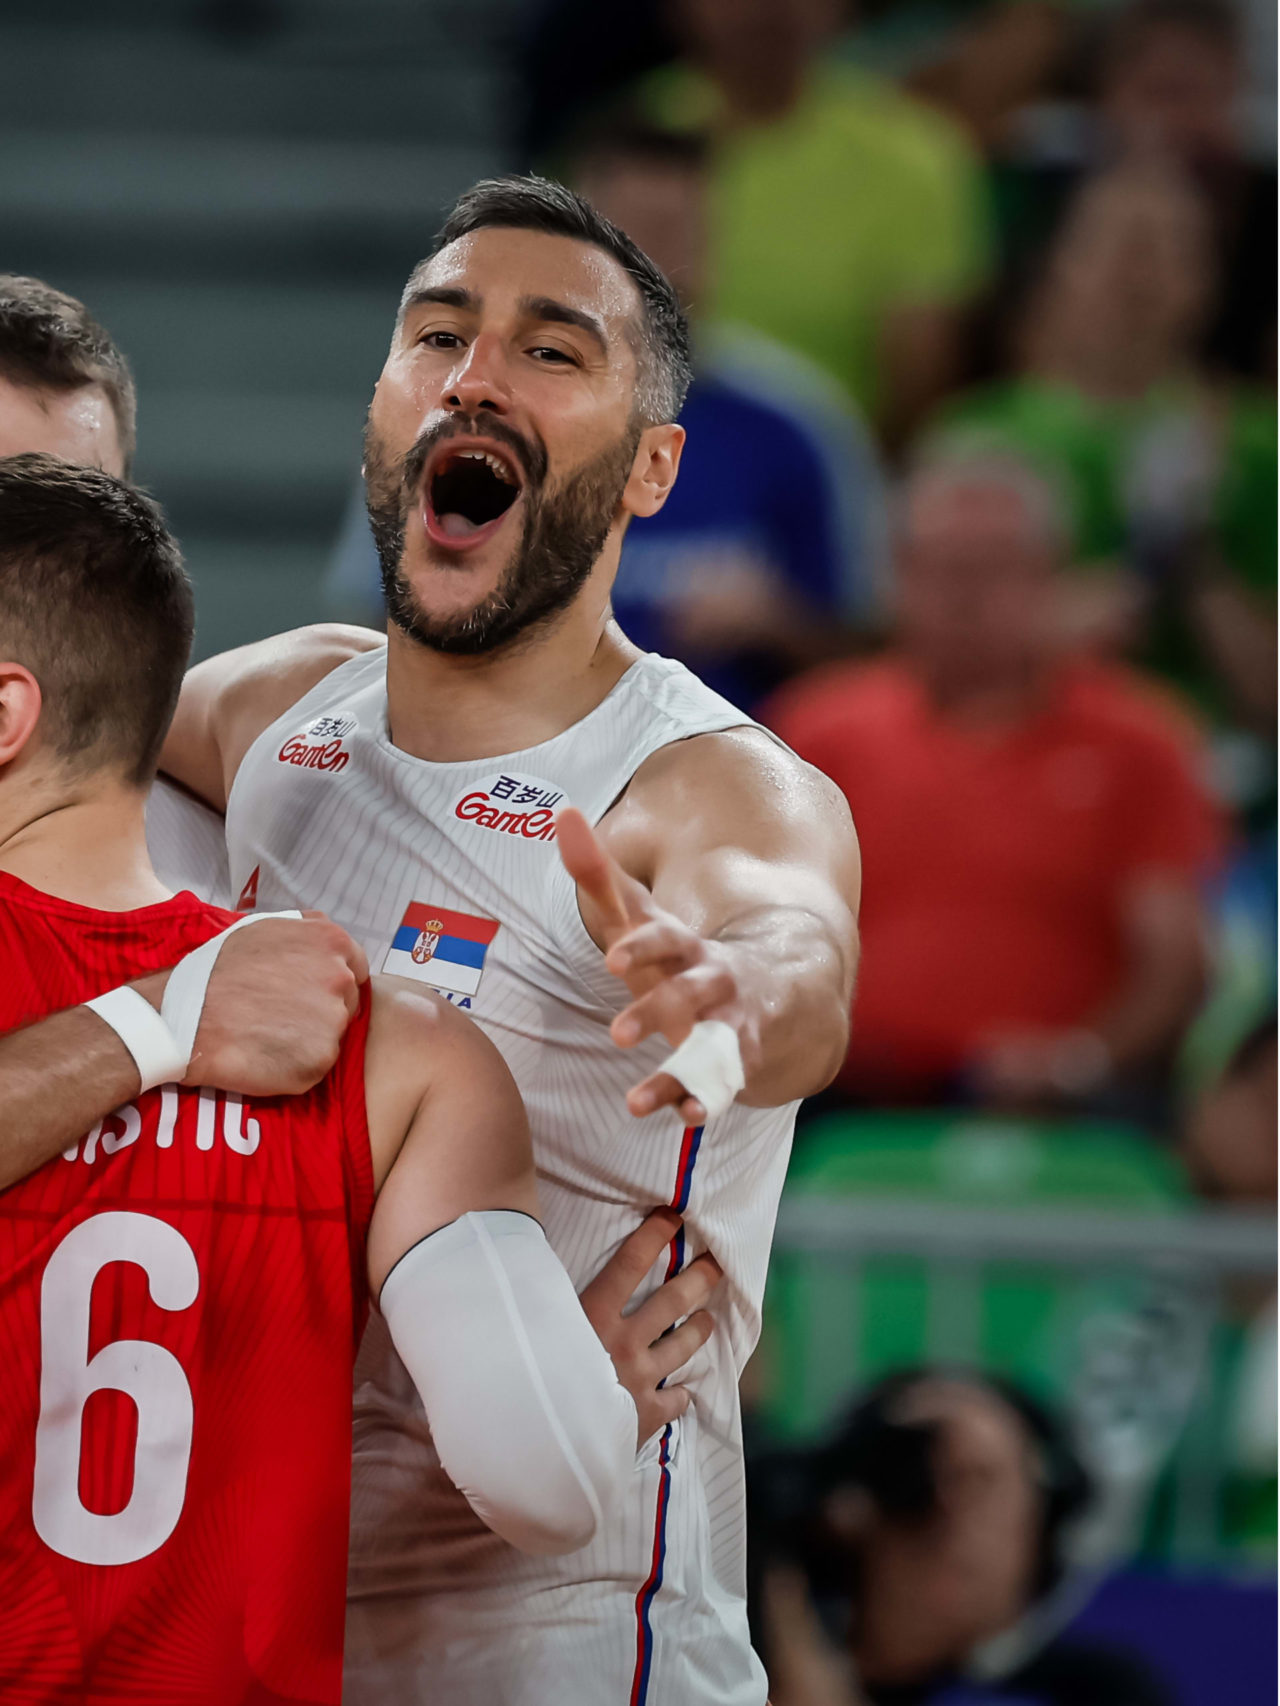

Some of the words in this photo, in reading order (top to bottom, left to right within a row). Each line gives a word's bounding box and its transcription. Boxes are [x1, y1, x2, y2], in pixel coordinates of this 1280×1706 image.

[308, 717, 357, 738] 百岁山
[488, 775, 564, 808] 百岁山
[32, 1211, 200, 1566] 6
